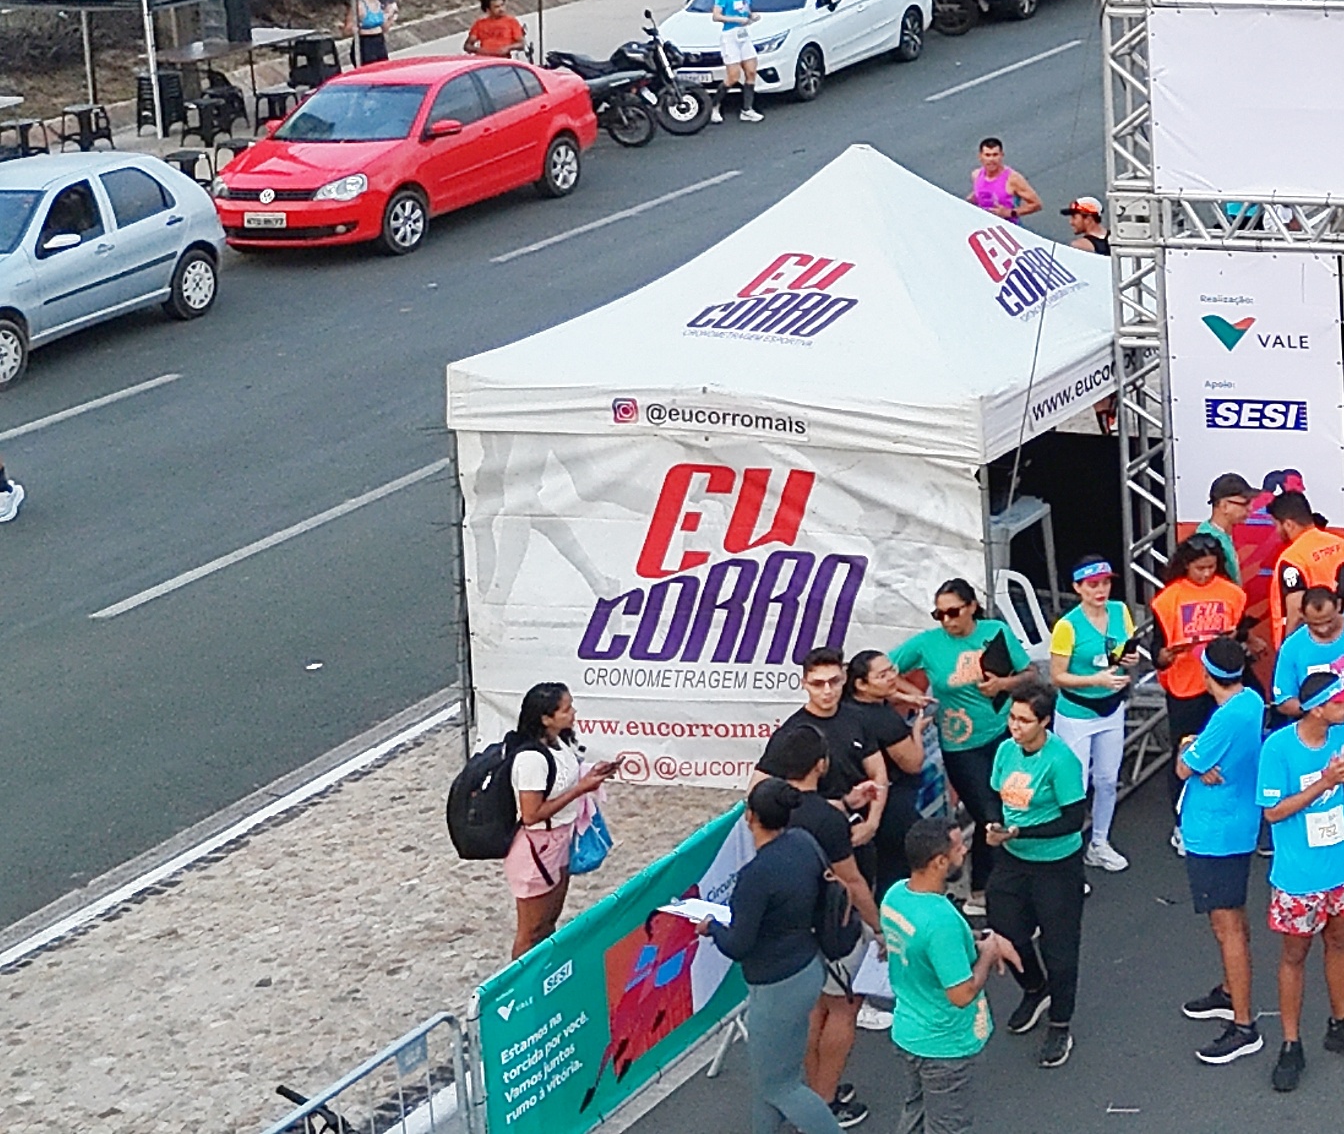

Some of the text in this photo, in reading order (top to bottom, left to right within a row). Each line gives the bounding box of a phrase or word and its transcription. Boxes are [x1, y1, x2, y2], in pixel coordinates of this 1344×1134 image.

[736, 252, 857, 299] EU
[1199, 294, 1254, 306] Realização:
[1257, 333, 1310, 349] VALE
[1204, 379, 1236, 389] Apoio:
[645, 402, 808, 437] @eucorromais
[1213, 401, 1299, 428] SESI
[636, 463, 816, 579] EU
[583, 667, 747, 690] CRONOMETRAGEM
[1318, 824, 1338, 839] 752
[501, 1012, 563, 1064] Estamos na
[502, 1048, 544, 1084] torcida
[545, 1032, 562, 1058] por
[504, 1043, 575, 1103] Vamos juntos
[506, 1094, 537, 1125] rumo
